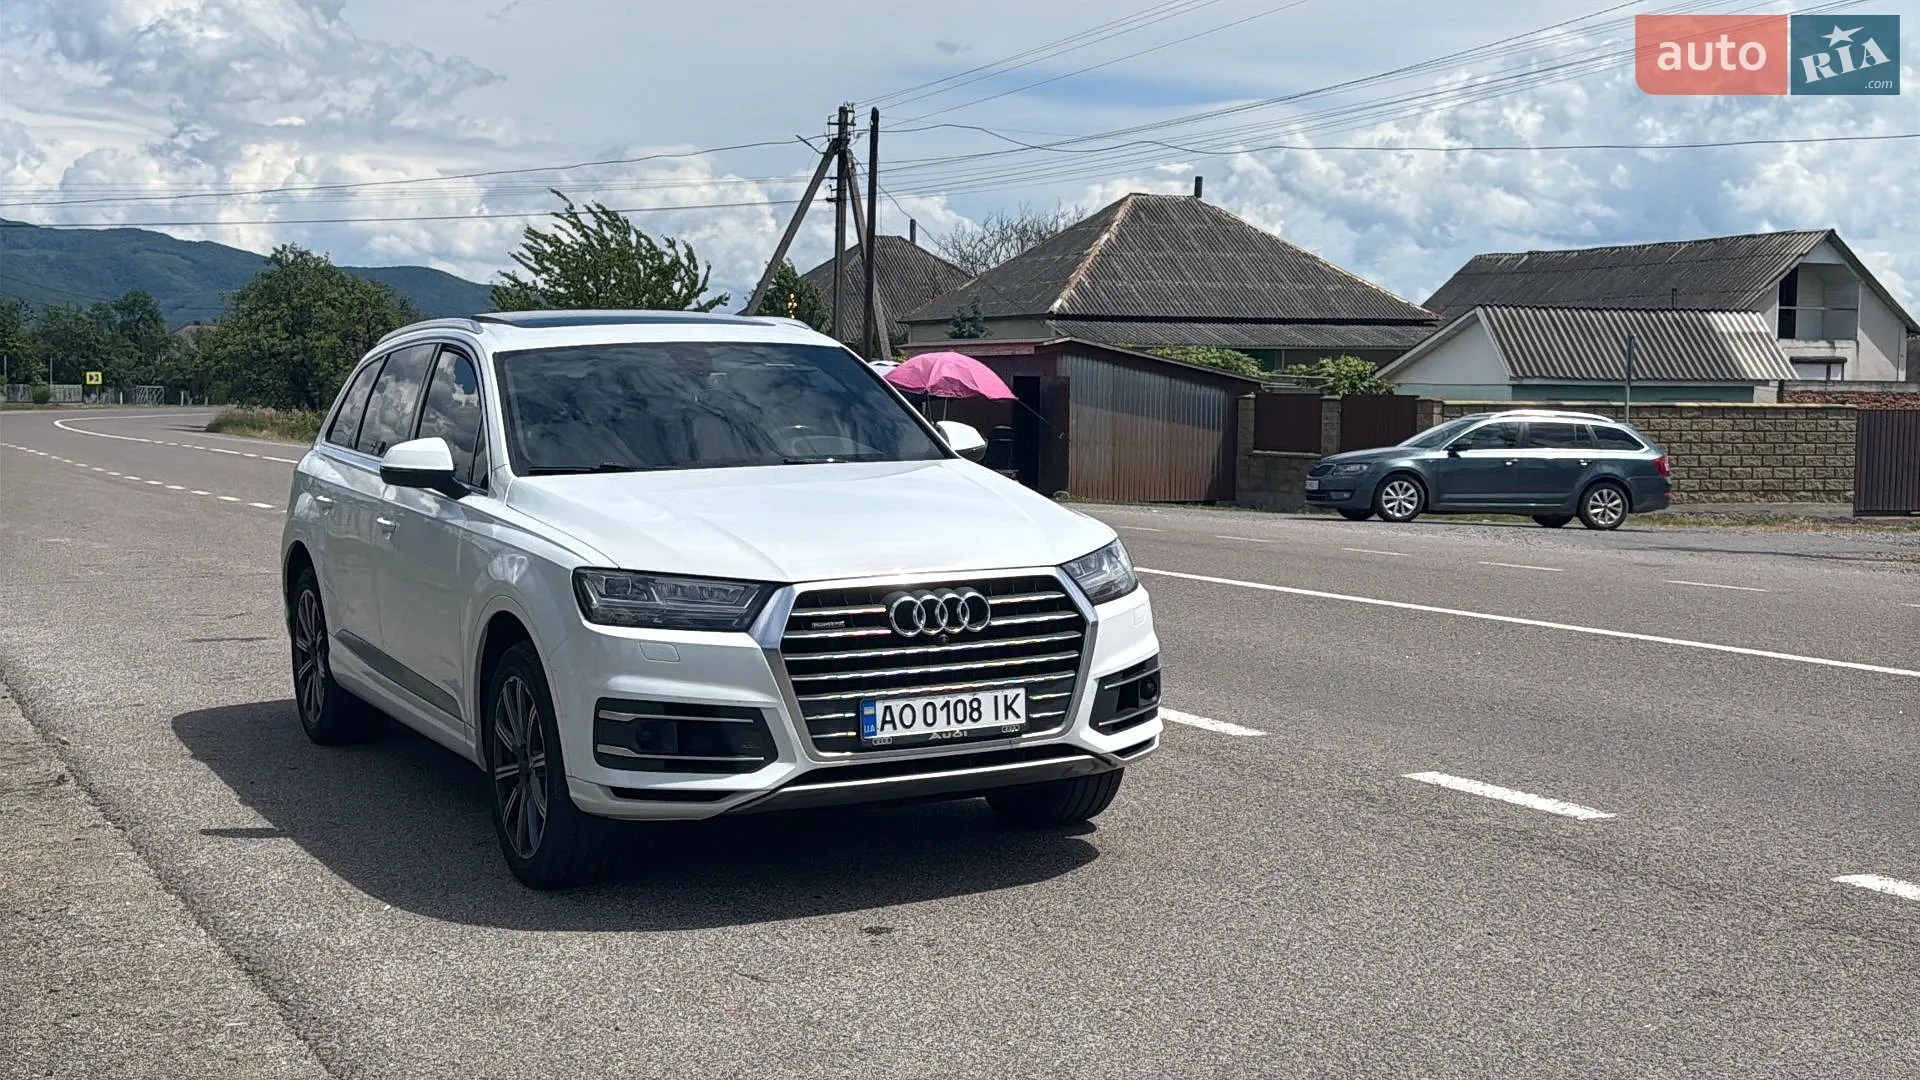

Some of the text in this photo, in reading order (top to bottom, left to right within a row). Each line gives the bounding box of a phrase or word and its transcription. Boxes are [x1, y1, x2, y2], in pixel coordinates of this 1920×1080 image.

[880, 693, 1021, 731] AO 0108 IK
[863, 724, 876, 733] UA
